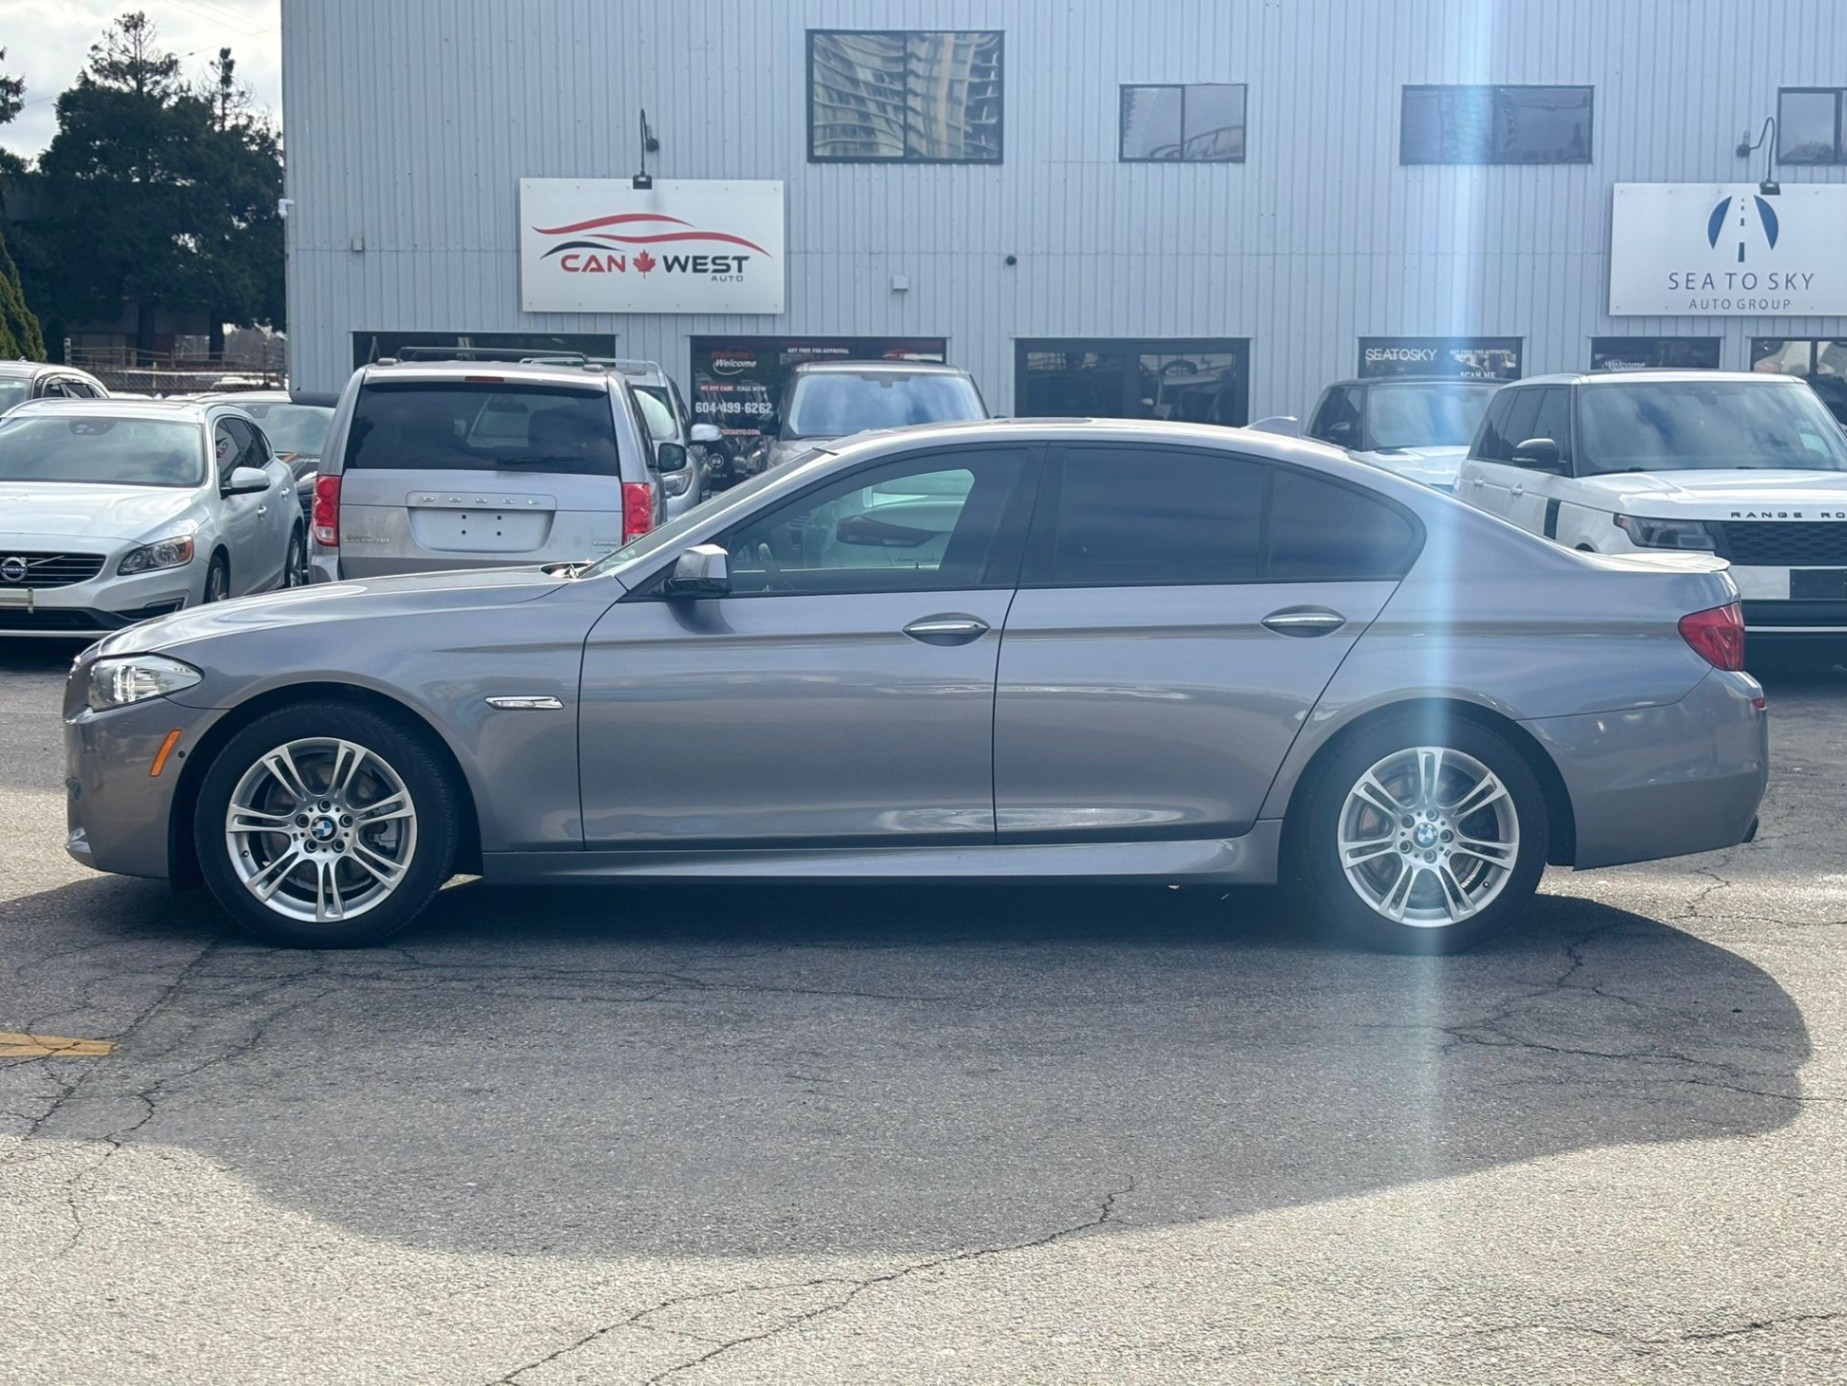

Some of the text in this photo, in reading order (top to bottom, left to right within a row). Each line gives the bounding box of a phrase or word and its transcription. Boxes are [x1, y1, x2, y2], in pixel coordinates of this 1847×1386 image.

[560, 254, 750, 274] CAN WEST
[710, 275, 744, 283] AUTO
[1668, 272, 1815, 291] SEA TO SKY
[1688, 298, 1792, 310] AUTO GROUP
[1365, 348, 1437, 361] SEATOSKY
[715, 359, 757, 368] Welcome
[695, 402, 773, 414] 604-499-6262
[1730, 511, 1803, 519] RANGE
